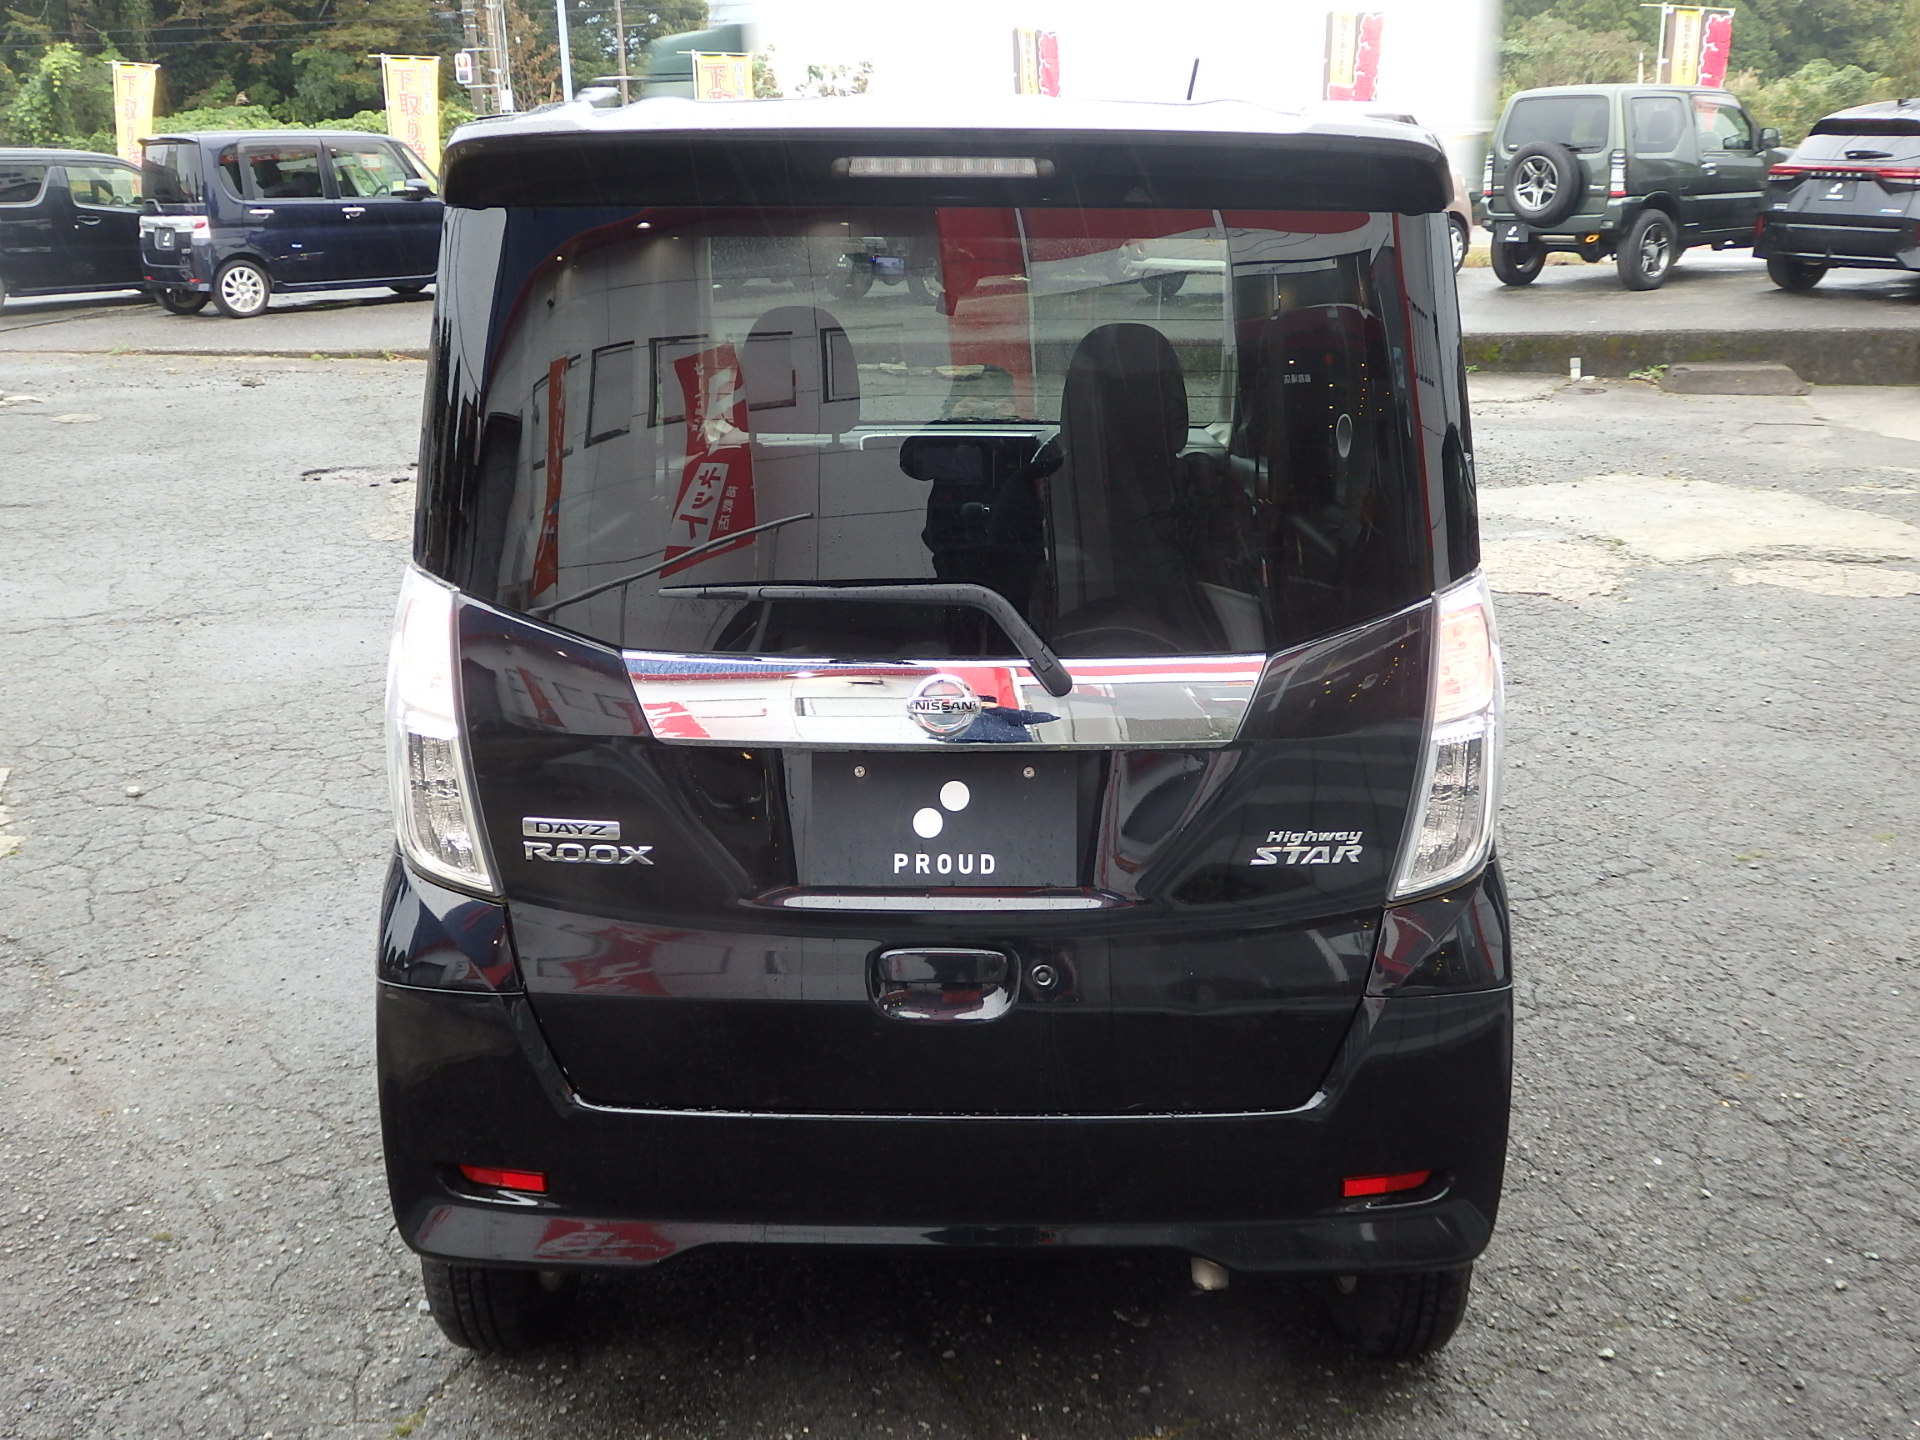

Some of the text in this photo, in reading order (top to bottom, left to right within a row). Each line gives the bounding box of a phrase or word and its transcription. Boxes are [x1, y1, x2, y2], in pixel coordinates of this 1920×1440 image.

[914, 701, 973, 712] NISSAN
[535, 822, 607, 836] DAYZ
[1266, 831, 1363, 847] Highway
[523, 841, 655, 865] ROOX
[1249, 845, 1363, 866] STAR
[893, 852, 996, 875] PROUD
